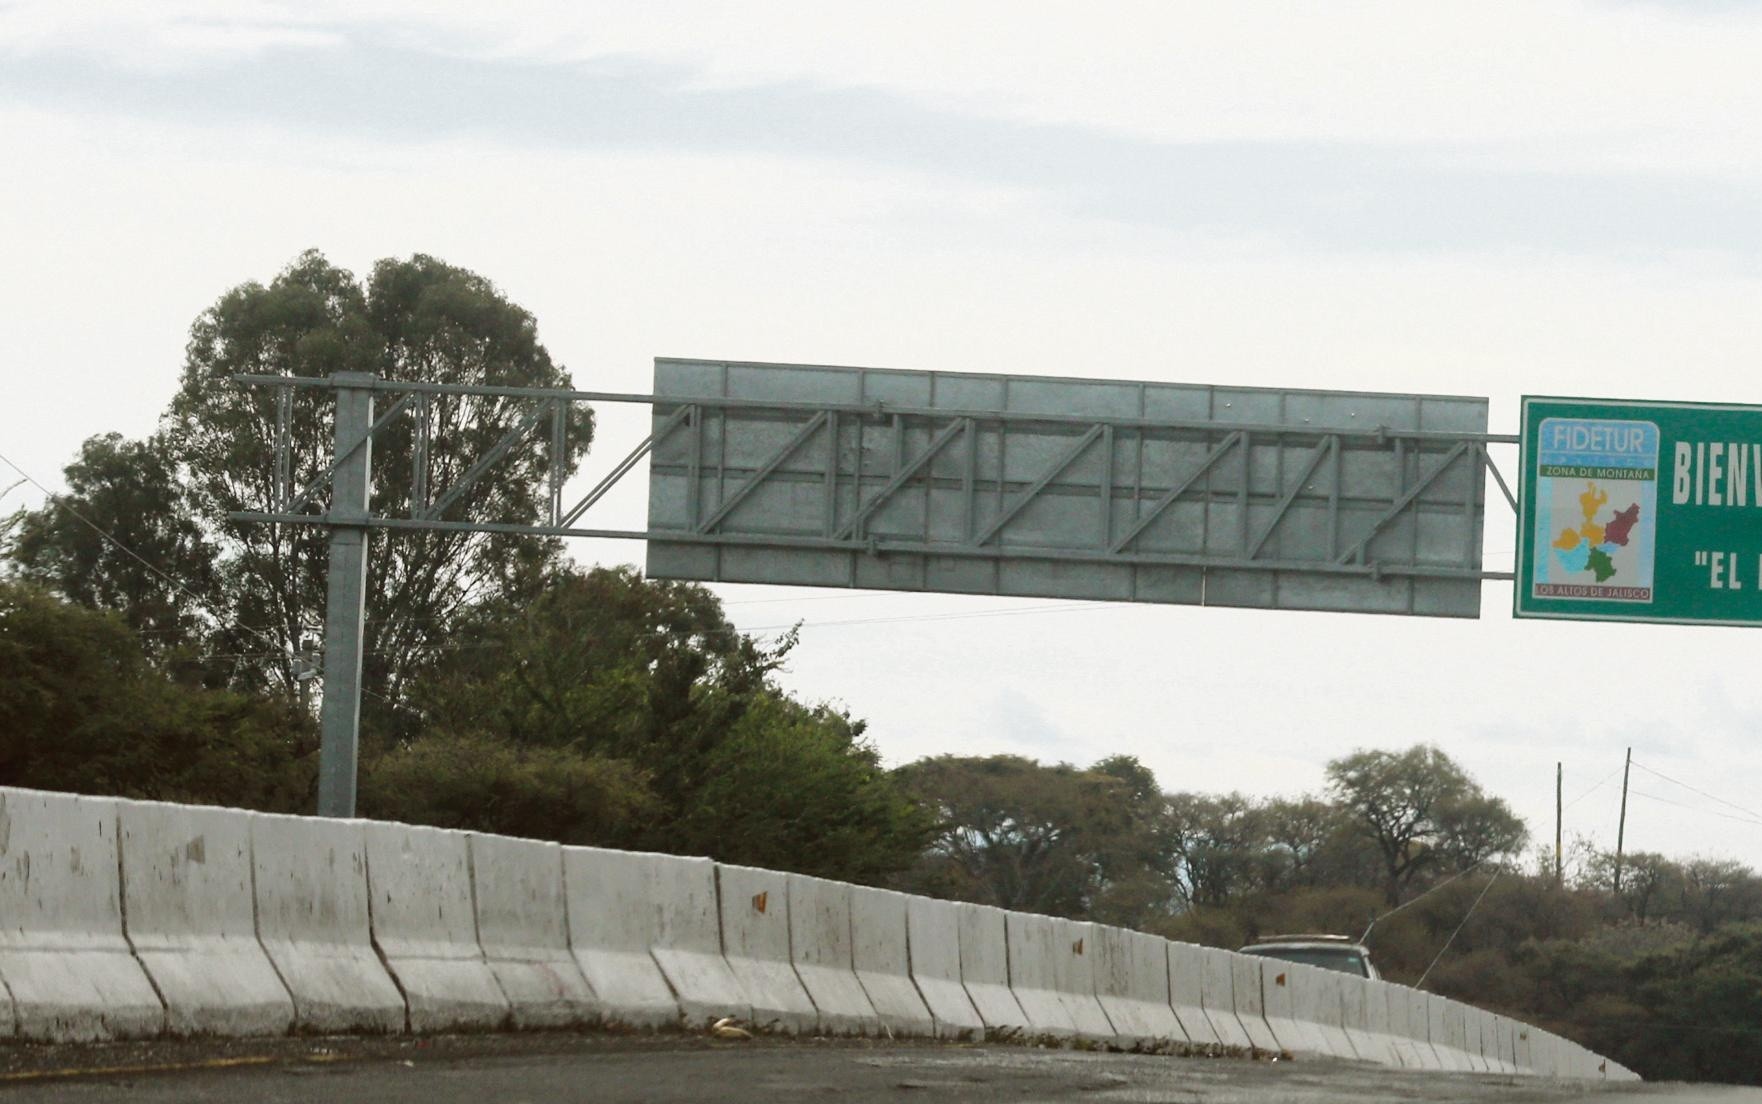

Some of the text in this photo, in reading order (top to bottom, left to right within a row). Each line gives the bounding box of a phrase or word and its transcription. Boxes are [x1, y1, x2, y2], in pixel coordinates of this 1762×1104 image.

[1553, 425, 1645, 452] FIDETUR
[1546, 466, 1577, 477] ZONA
[1580, 467, 1593, 478] DE
[1694, 551, 1742, 589] "EL
[1590, 586, 1606, 597] DE
[1608, 588, 1649, 599] JALISCO
